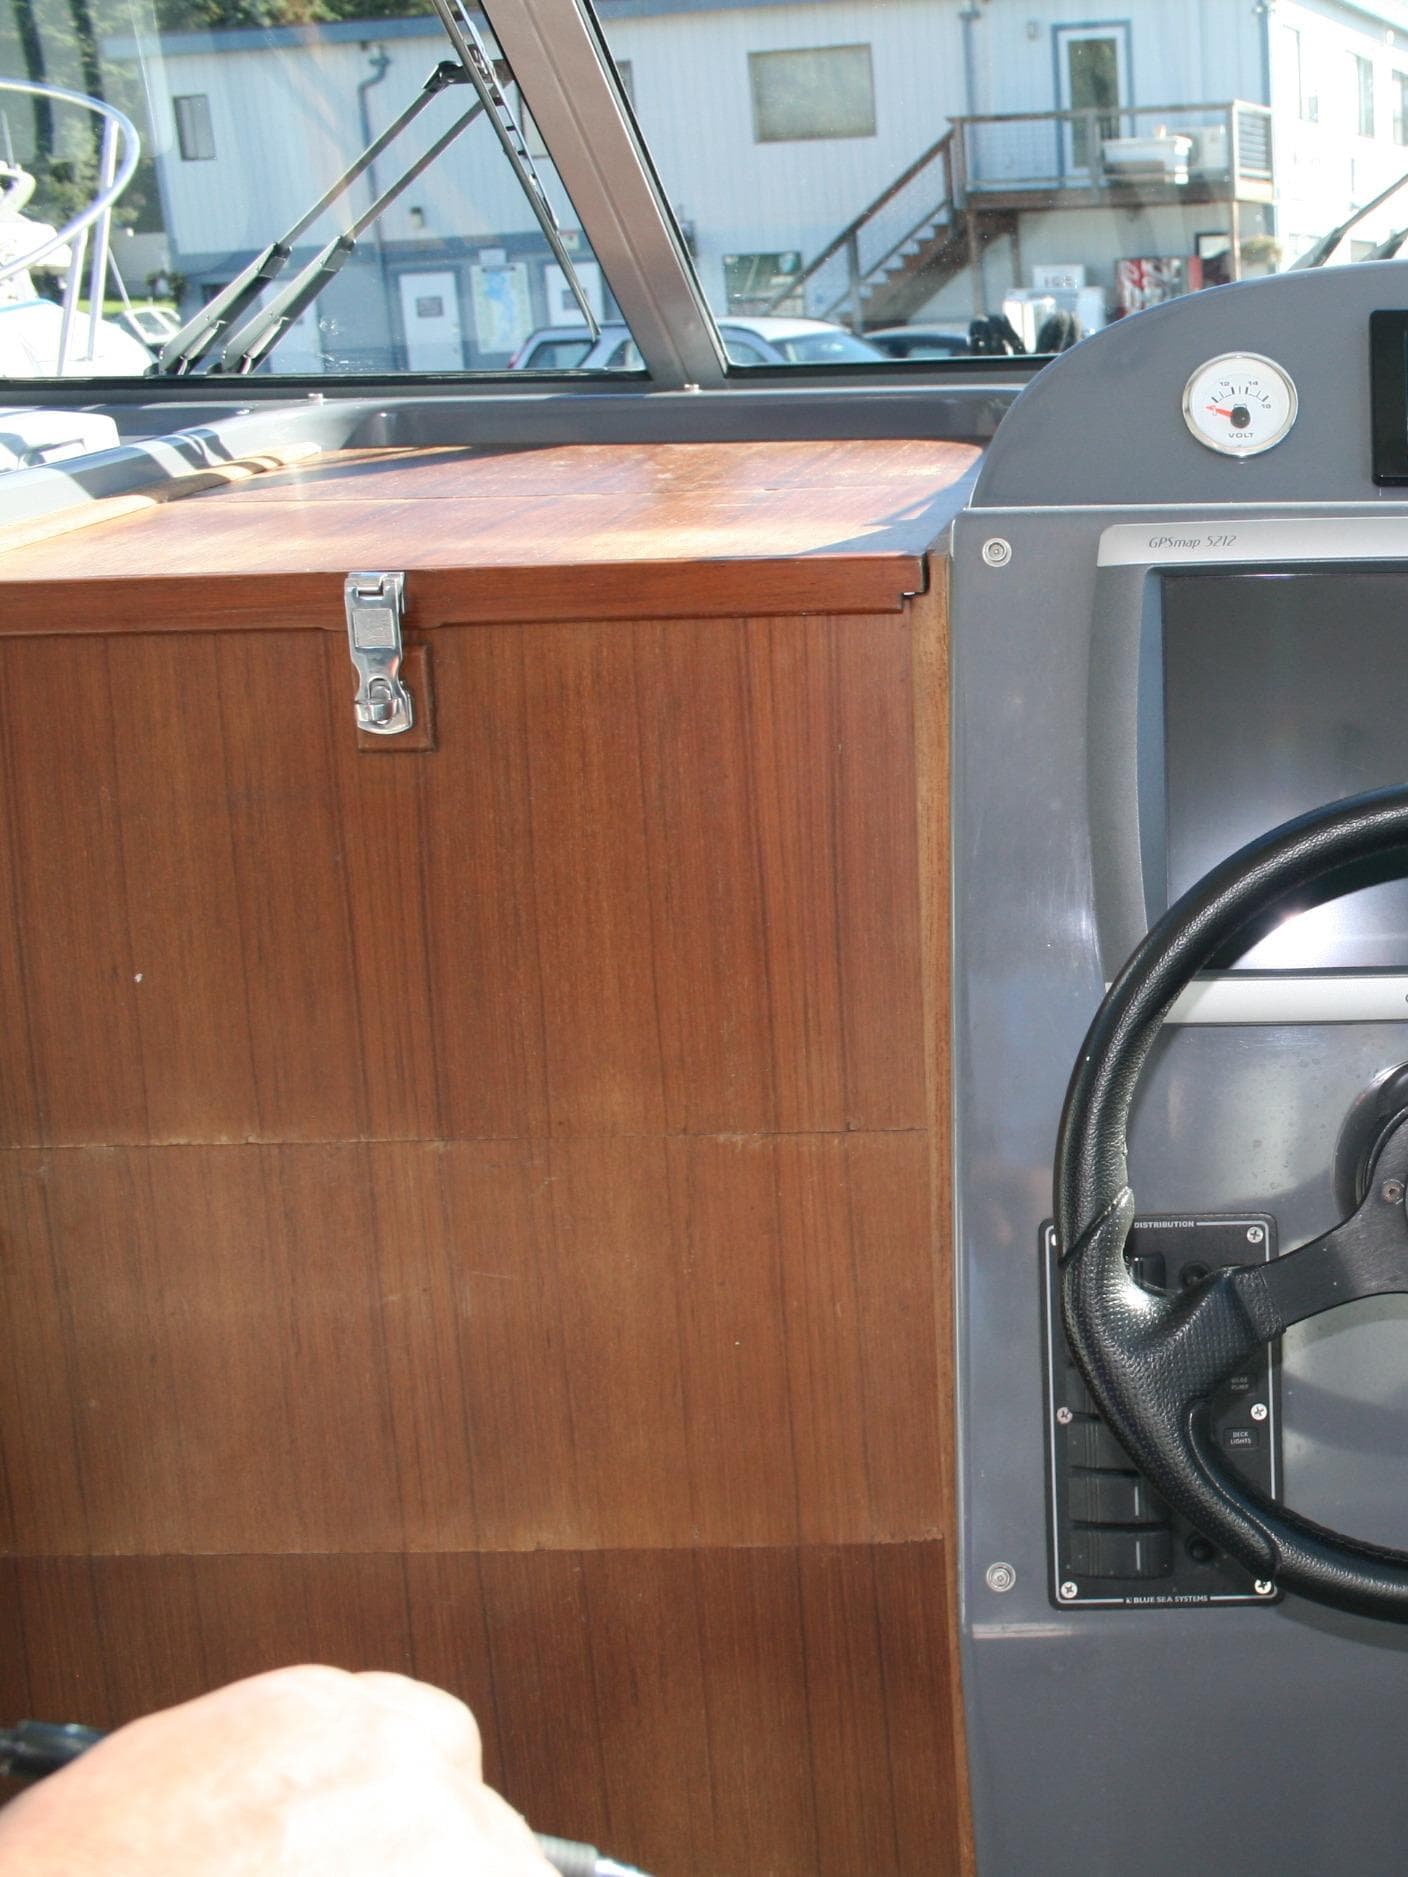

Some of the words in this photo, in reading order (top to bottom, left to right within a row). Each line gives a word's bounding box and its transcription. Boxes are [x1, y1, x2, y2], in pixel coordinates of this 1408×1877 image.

[1148, 536, 1201, 549] GPSmap
[1206, 534, 1237, 547] 5212
[1134, 1220, 1195, 1229] DISTRIBUTION
[1133, 1596, 1154, 1604] BLUE
[1156, 1595, 1173, 1603] SEA
[1174, 1594, 1208, 1603] SYSTEMS
